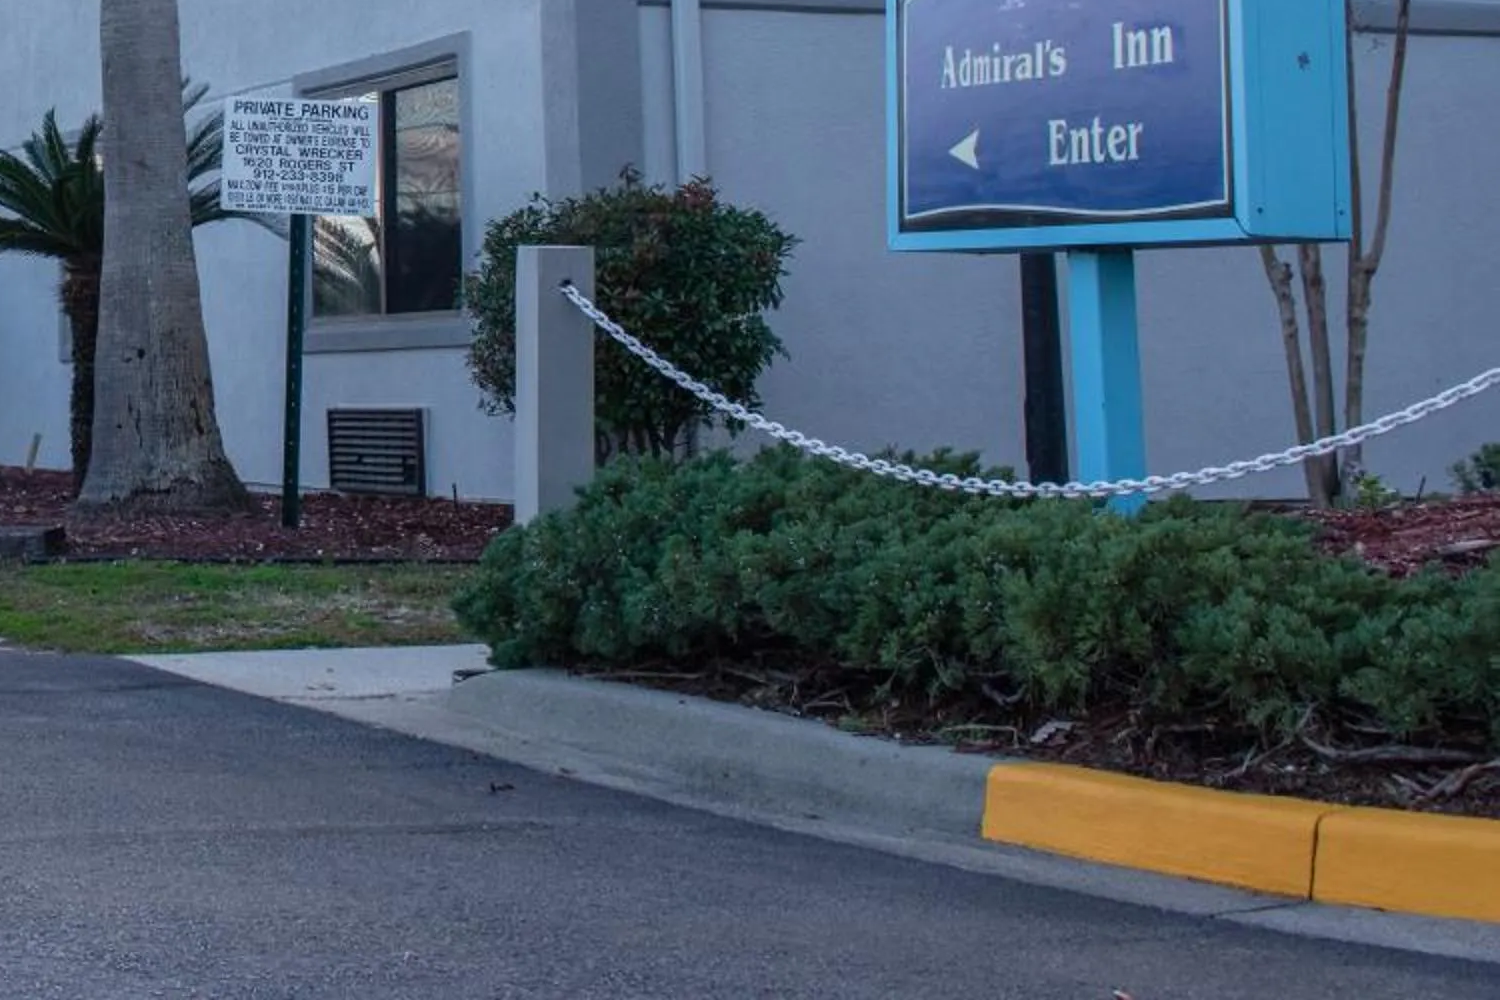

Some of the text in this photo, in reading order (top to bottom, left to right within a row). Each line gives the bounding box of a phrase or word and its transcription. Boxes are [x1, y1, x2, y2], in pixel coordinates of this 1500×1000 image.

[941, 21, 1173, 89] Admiral's Inn
[234, 101, 295, 116] PRIVATE
[302, 103, 369, 120] PARKING
[247, 121, 308, 133] UNTHORED
[1048, 116, 1143, 165] Enter
[235, 145, 363, 160] CRYSTAL WRECKER
[279, 159, 332, 171] ROGERS
[340, 162, 355, 172] ST
